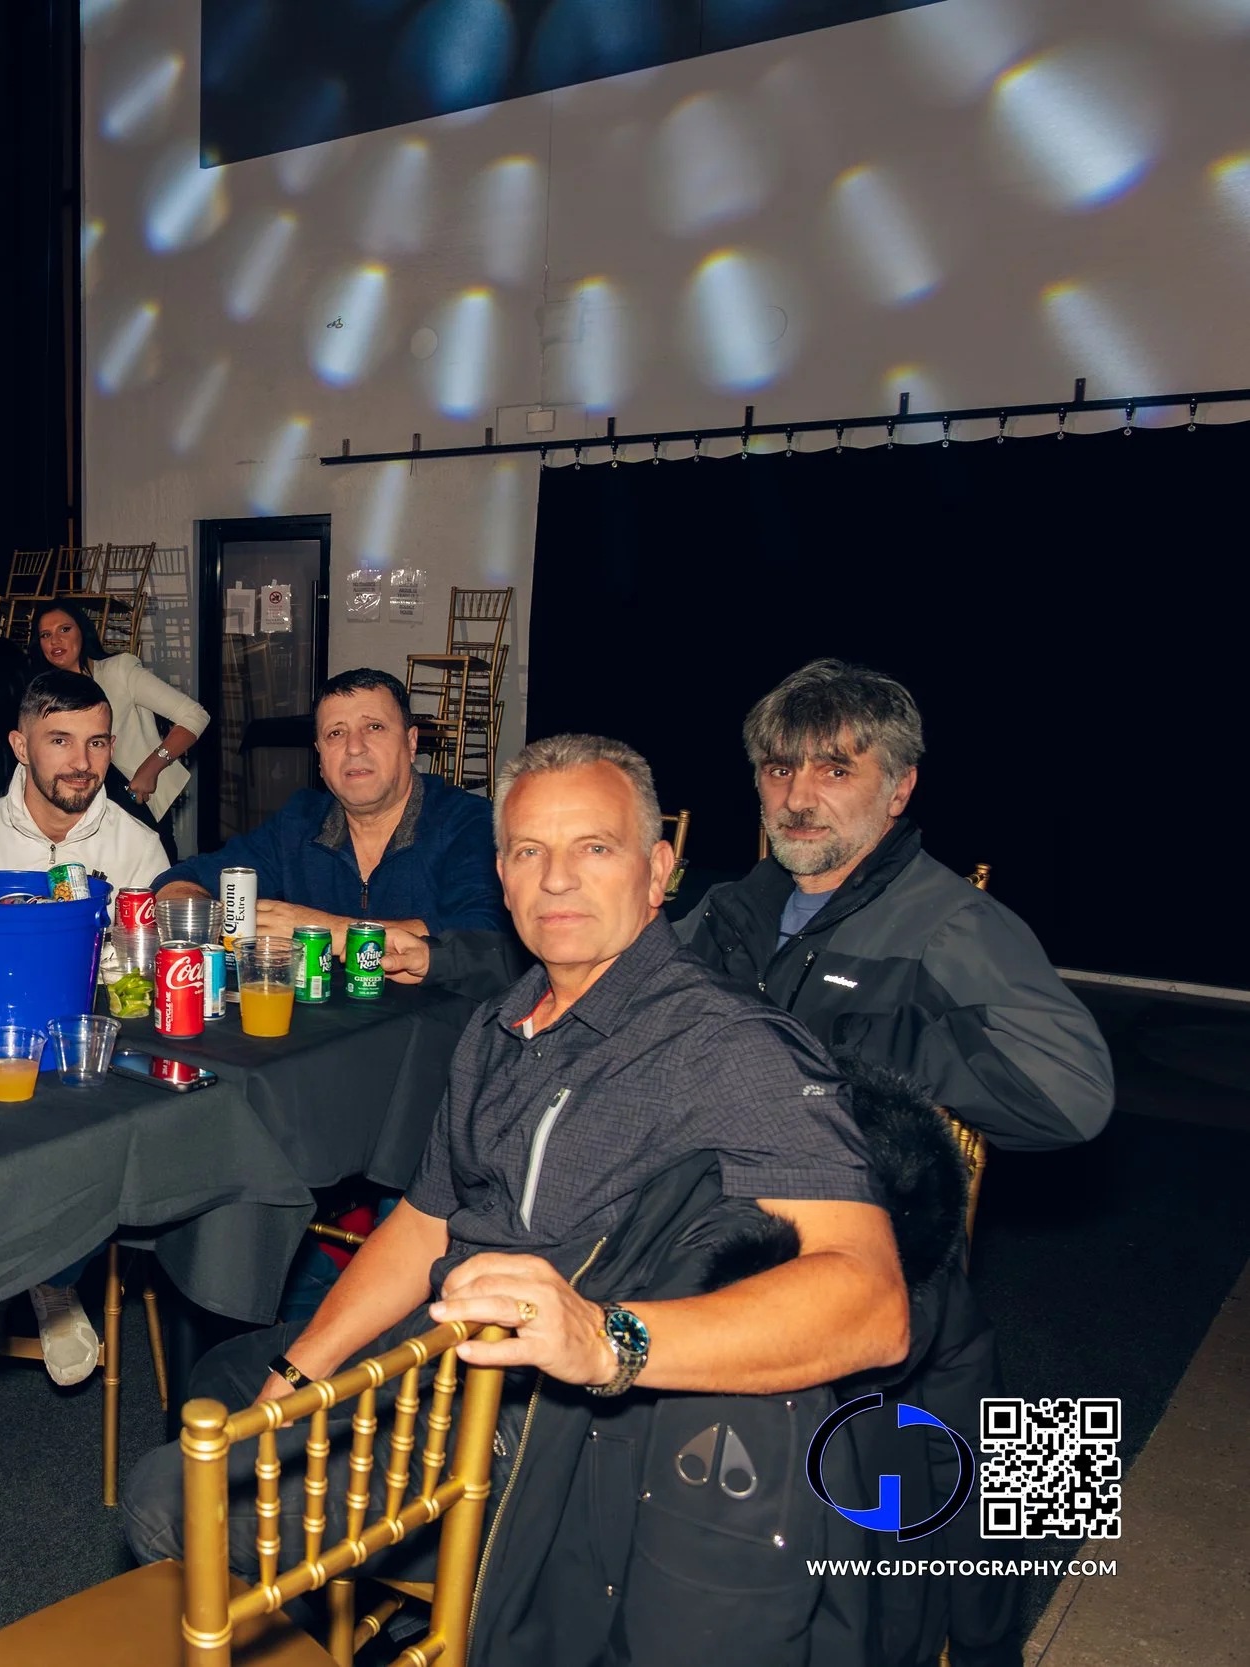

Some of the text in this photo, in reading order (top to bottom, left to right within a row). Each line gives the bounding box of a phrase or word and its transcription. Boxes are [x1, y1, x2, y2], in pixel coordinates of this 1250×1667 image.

[224, 884, 238, 934] Corona
[235, 896, 245, 922] Extra
[356, 950, 383, 964] White
[359, 957, 382, 970] Rock
[165, 991, 172, 1003] ME
